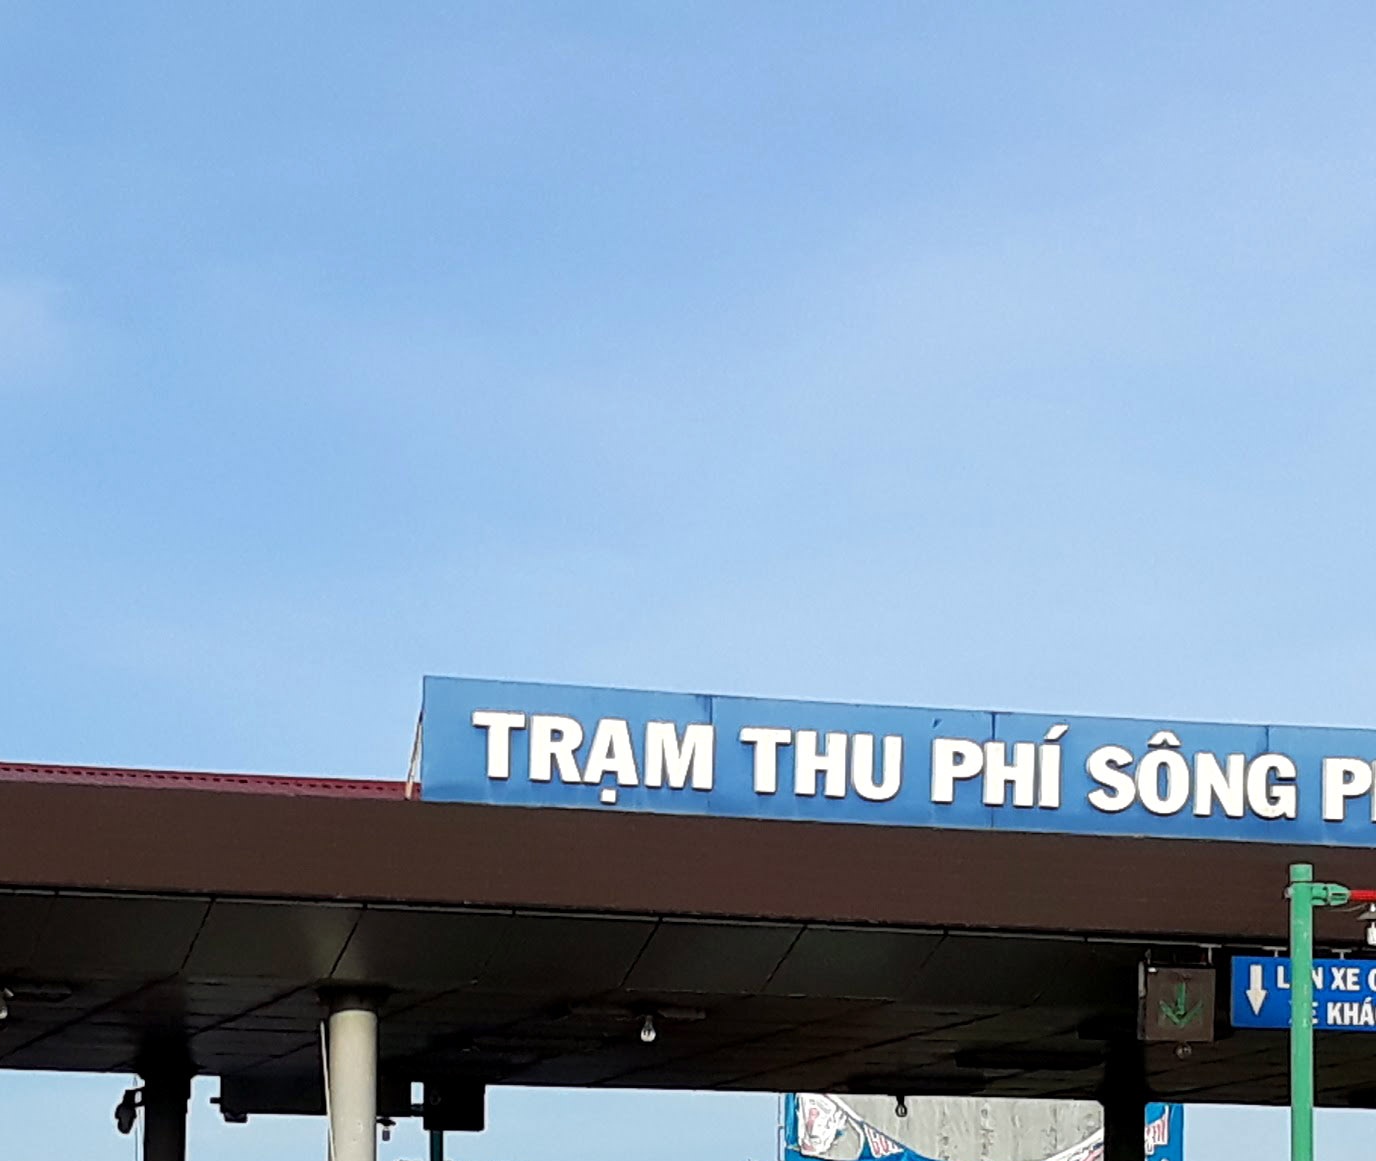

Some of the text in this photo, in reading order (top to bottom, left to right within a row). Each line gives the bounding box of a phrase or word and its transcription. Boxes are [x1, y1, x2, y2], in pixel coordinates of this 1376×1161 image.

[471, 709, 715, 804] TRẠM
[739, 726, 904, 802] THU
[931, 725, 1071, 809] PHÍ
[1085, 730, 1298, 821] SÔNG
[1276, 965, 1324, 990] LN
[1331, 967, 1361, 992] XE
